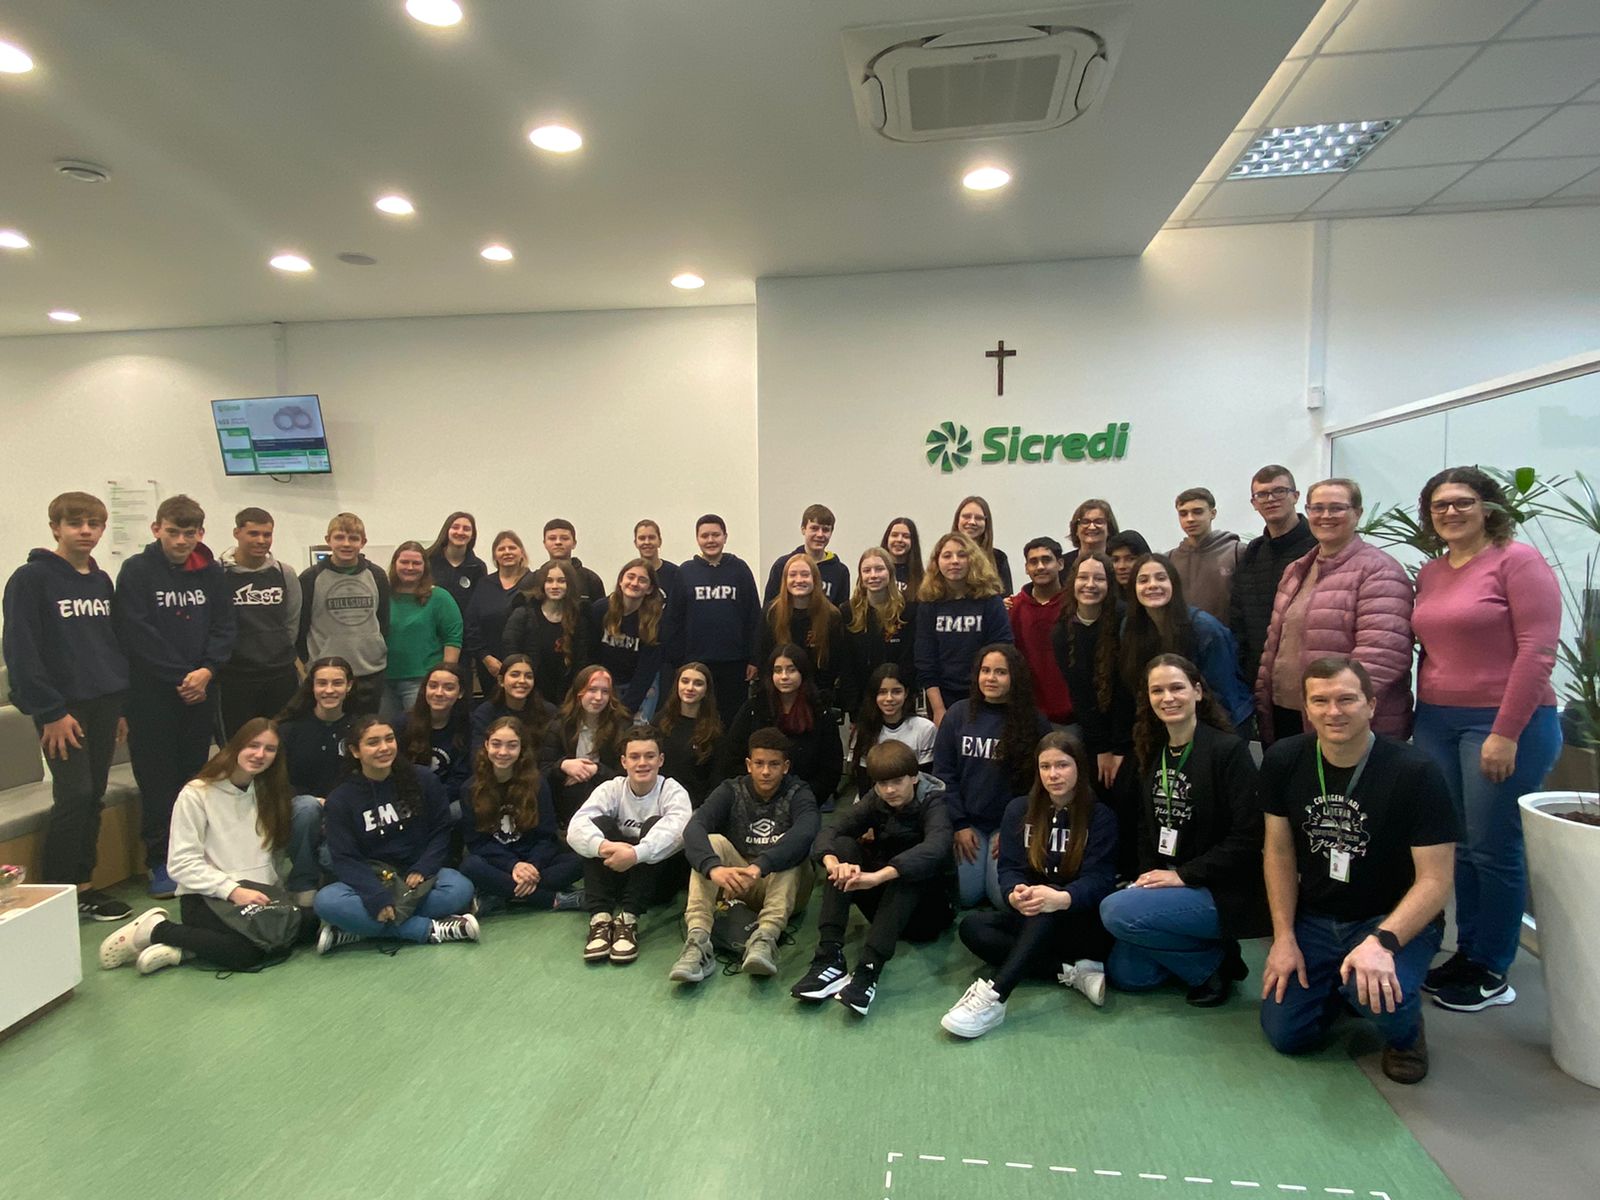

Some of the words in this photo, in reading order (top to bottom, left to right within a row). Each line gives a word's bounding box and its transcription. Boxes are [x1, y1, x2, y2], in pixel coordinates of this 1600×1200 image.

[981, 422, 1130, 463] Sicredi
[694, 585, 737, 600] EMPI
[935, 615, 983, 632] EMPI
[1313, 794, 1345, 805] COAGEM
